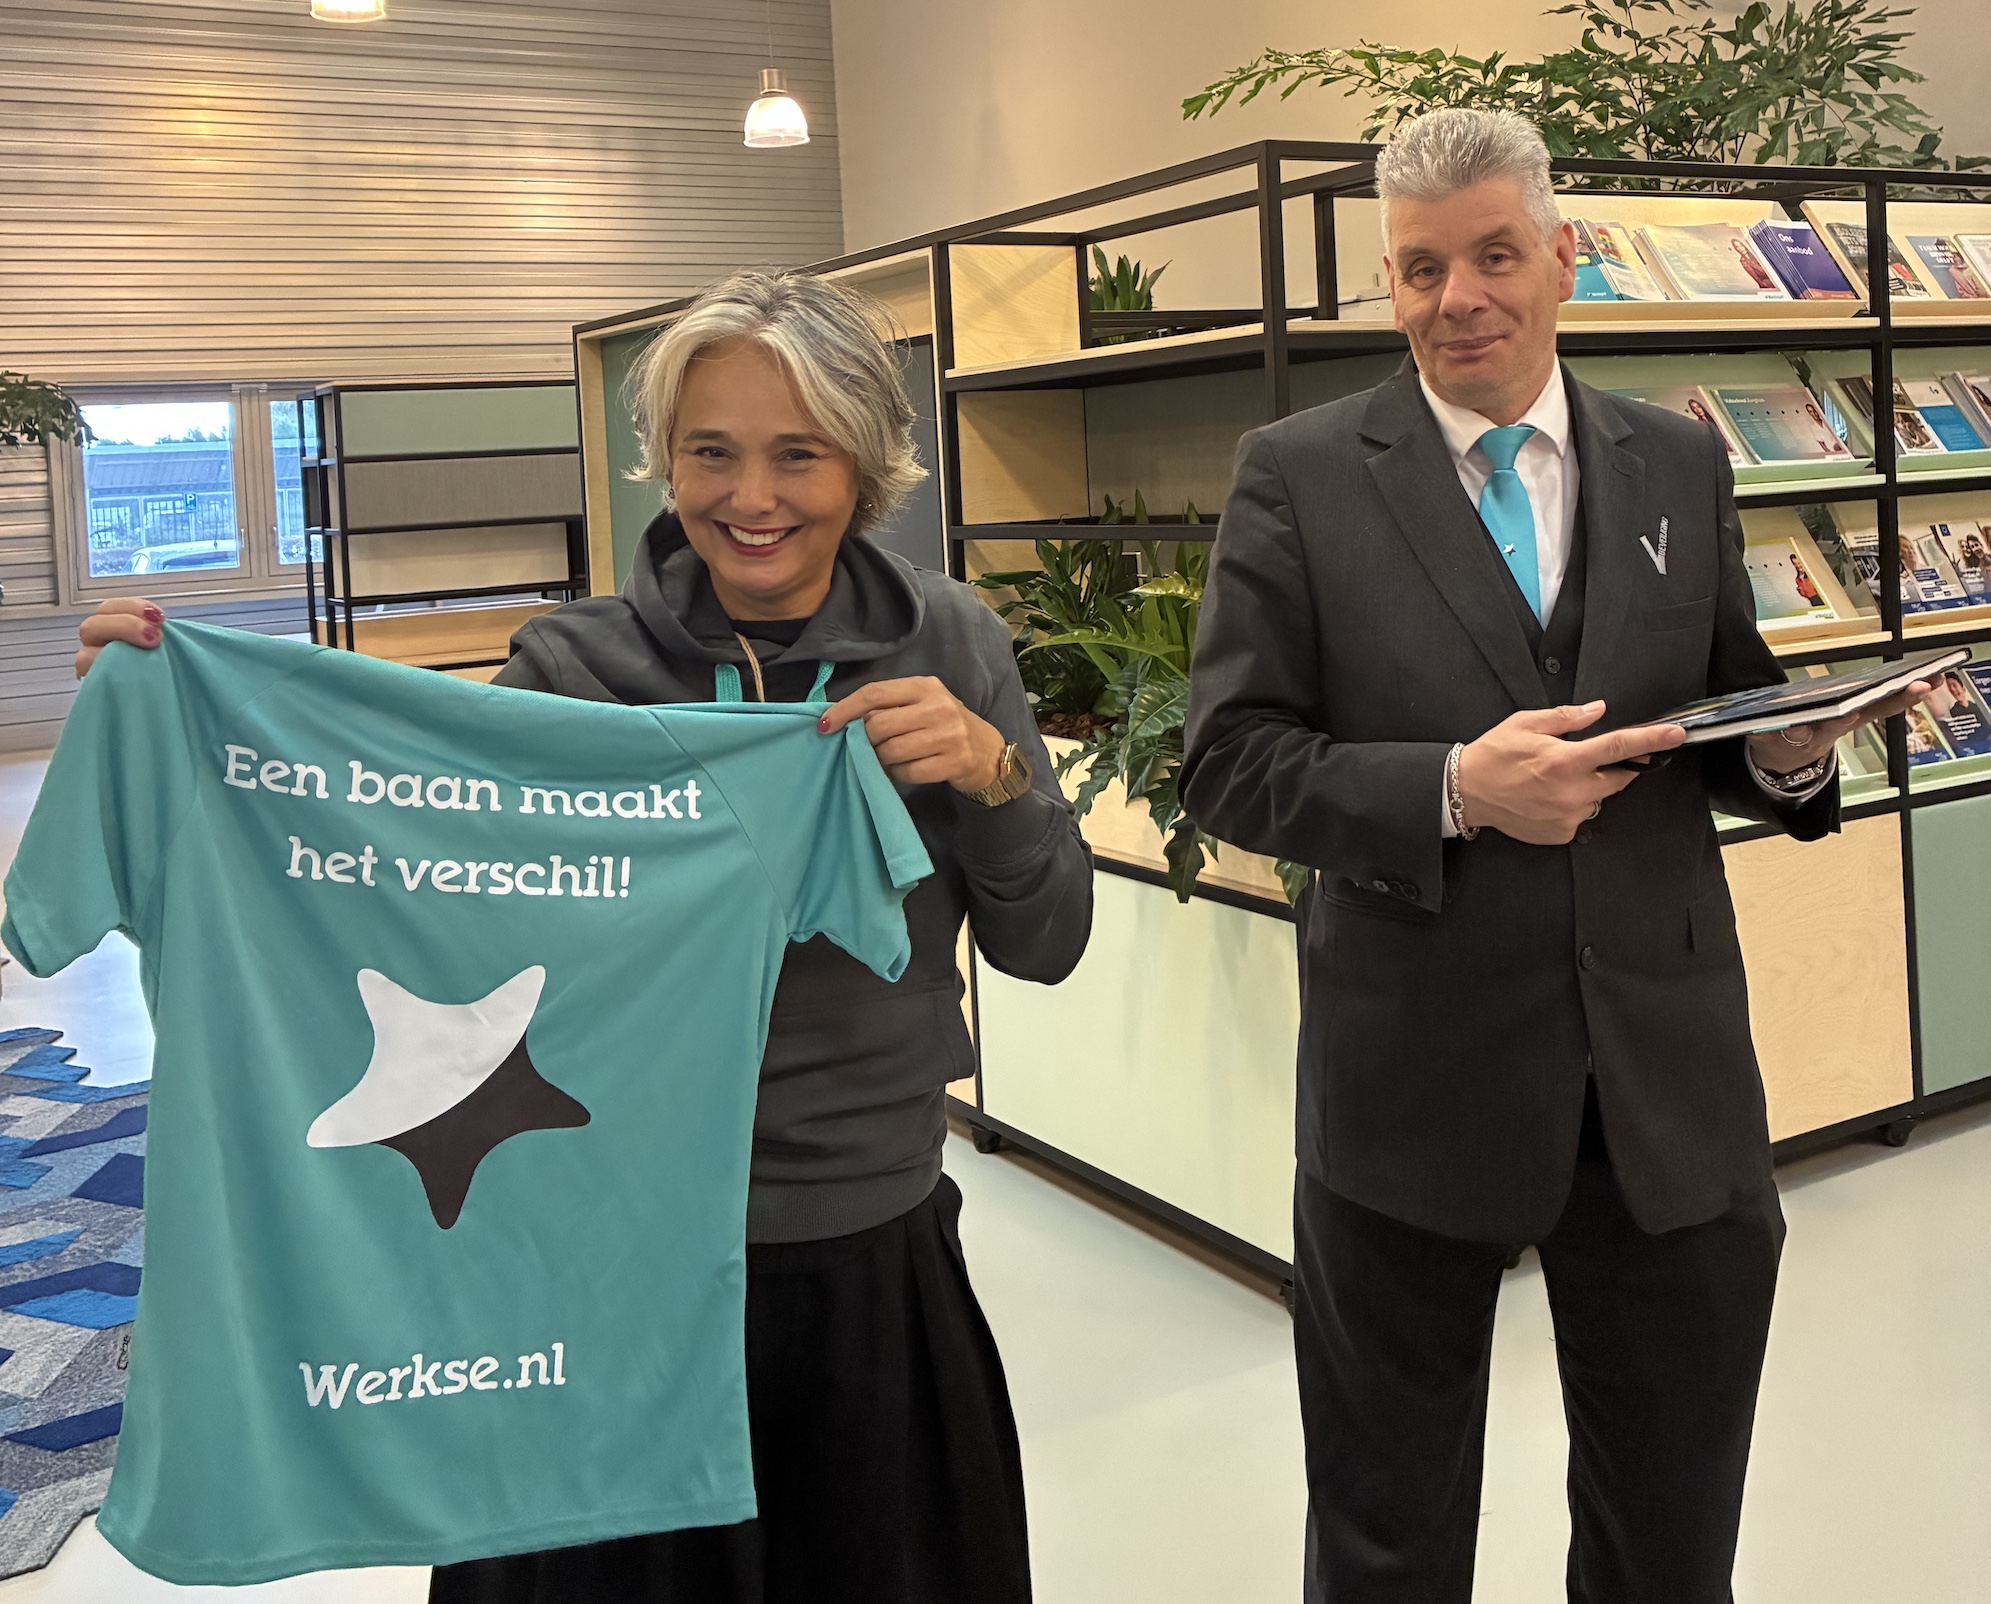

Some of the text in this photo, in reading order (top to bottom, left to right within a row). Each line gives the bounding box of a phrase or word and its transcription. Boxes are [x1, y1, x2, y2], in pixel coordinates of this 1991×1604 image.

[1778, 233, 1794, 243] Ons
[186, 493, 195, 505] P
[223, 743, 703, 820] Een baan maakt
[285, 835, 632, 899] het verschil!
[298, 1341, 567, 1410] Werkse.nl
